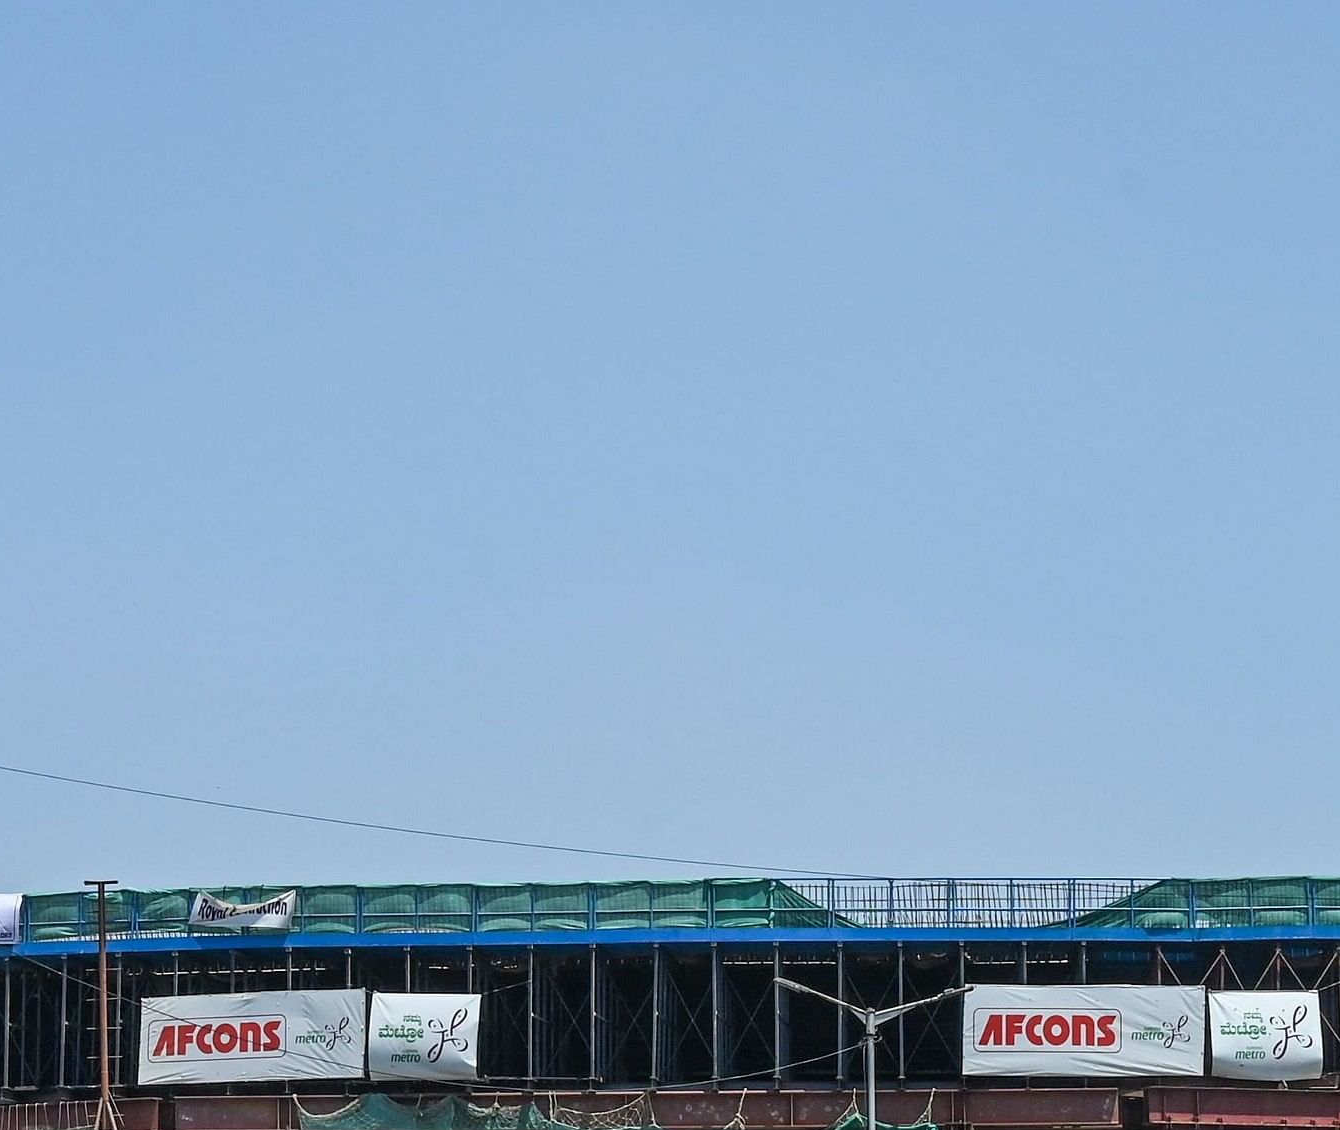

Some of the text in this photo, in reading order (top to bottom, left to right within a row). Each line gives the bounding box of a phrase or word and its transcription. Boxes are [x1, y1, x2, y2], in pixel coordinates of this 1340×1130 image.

[979, 1014, 1117, 1047] AFCONS
[1131, 1030, 1164, 1041] metro
[153, 1020, 282, 1057] AFCONS
[295, 1032, 326, 1044] metro
[391, 1053, 421, 1063] metro
[1235, 1050, 1266, 1060] metro
